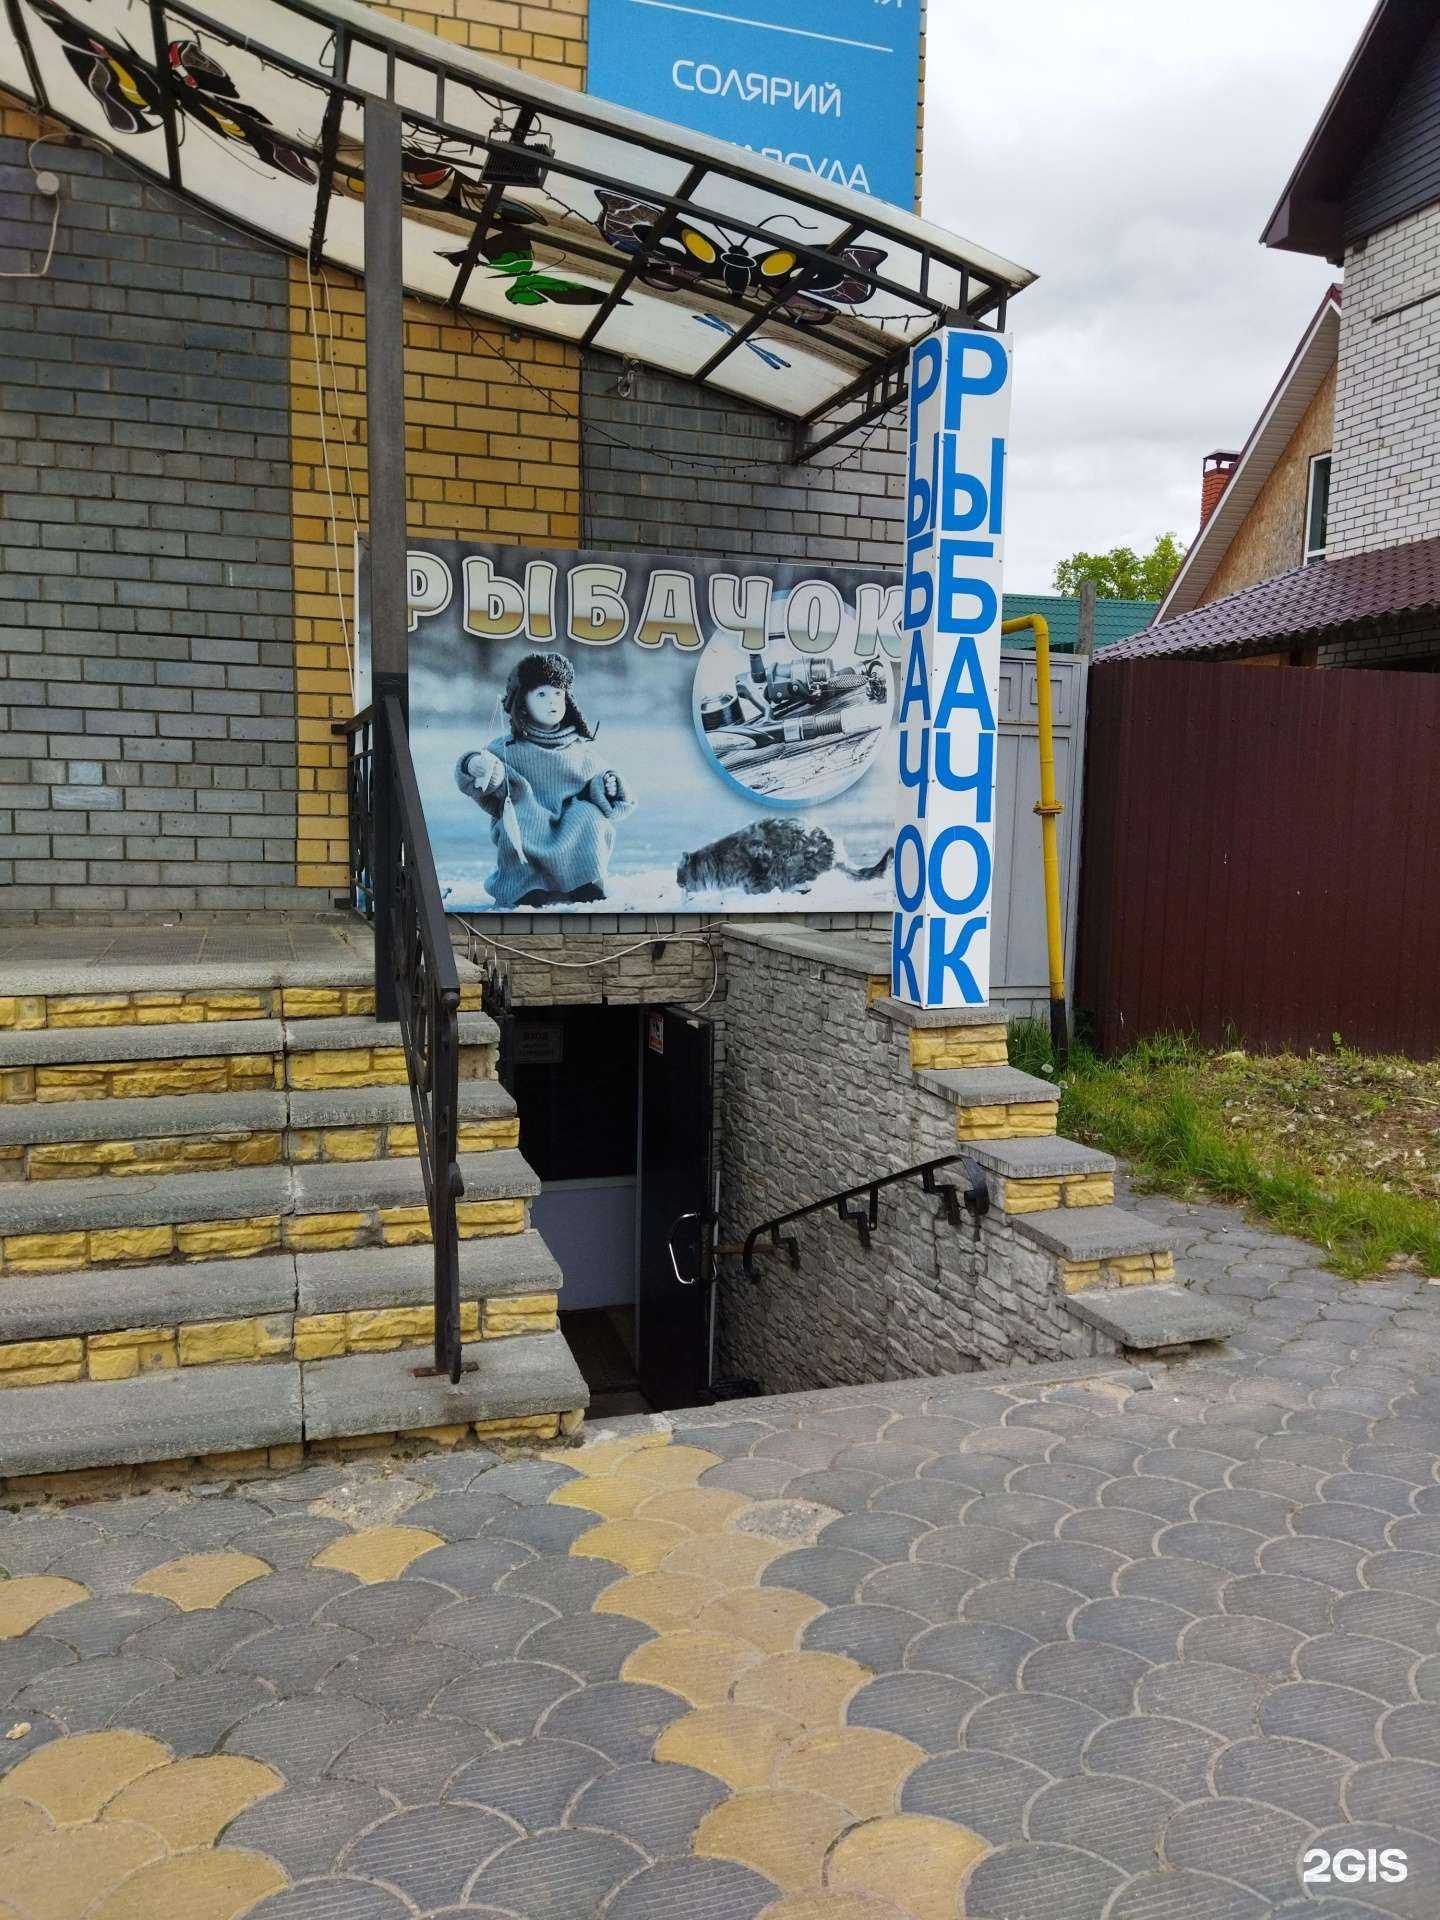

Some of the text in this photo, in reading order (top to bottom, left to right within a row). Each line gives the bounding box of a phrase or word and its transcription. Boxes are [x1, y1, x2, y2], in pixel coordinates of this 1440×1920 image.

[672, 60, 841, 118] СОЛЯРИЙ
[407, 550, 903, 662] РЫБАЧОК
[893, 337, 942, 1002] РЫБАЧОК
[927, 331, 1008, 1004] РЫБАЧОК
